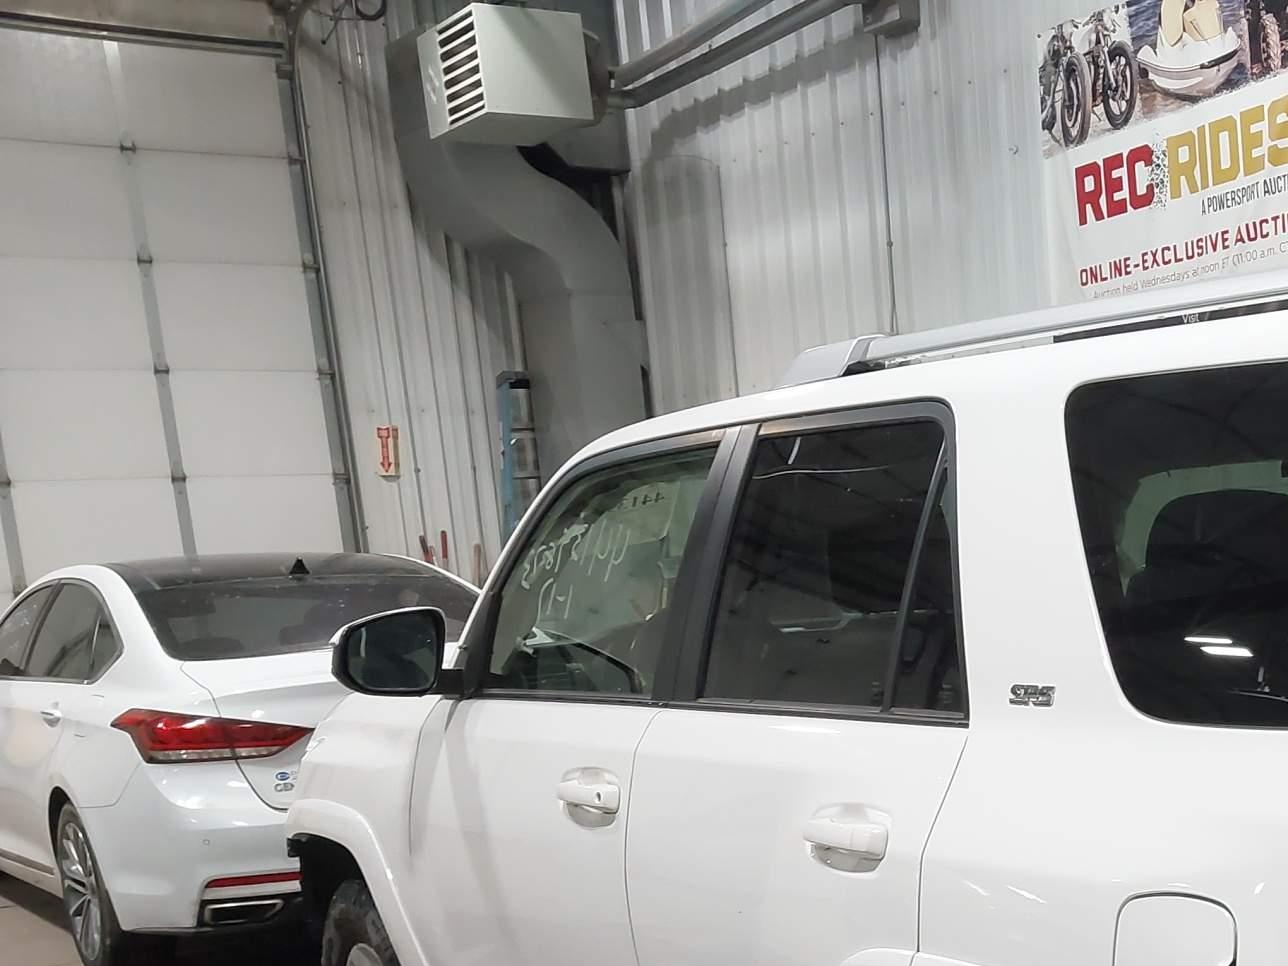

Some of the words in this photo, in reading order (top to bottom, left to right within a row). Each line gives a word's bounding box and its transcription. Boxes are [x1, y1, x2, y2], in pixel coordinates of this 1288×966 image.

[1075, 144, 1155, 226] REC
[1201, 199, 1207, 216] A
[1207, 181, 1260, 214] POWERSPORT
[1080, 229, 1230, 287] ONLINE-EXCLUSIVE
[1122, 281, 1138, 293] held
[1141, 271, 1190, 289] Wednesdays
[1191, 268, 1199, 278] at
[1200, 261, 1219, 274] noon
